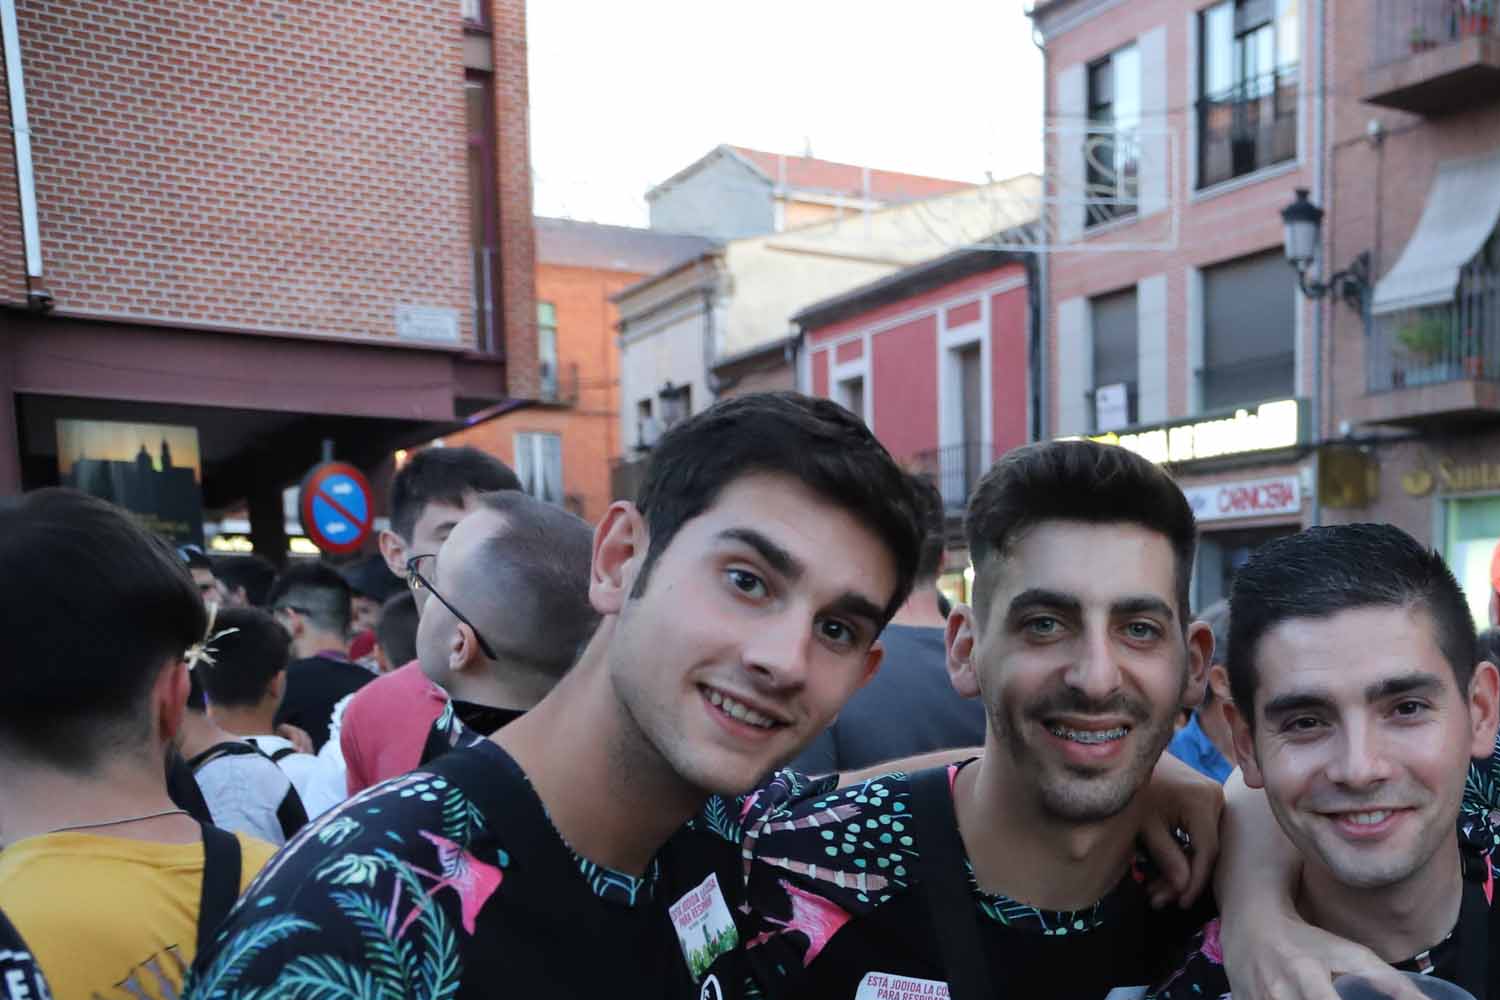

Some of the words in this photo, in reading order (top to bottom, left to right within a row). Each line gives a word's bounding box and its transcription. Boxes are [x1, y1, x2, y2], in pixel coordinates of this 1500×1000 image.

[867, 976, 888, 988] ESTÁ
[890, 979, 921, 993] JODIDA
[924, 984, 934, 994] LA
